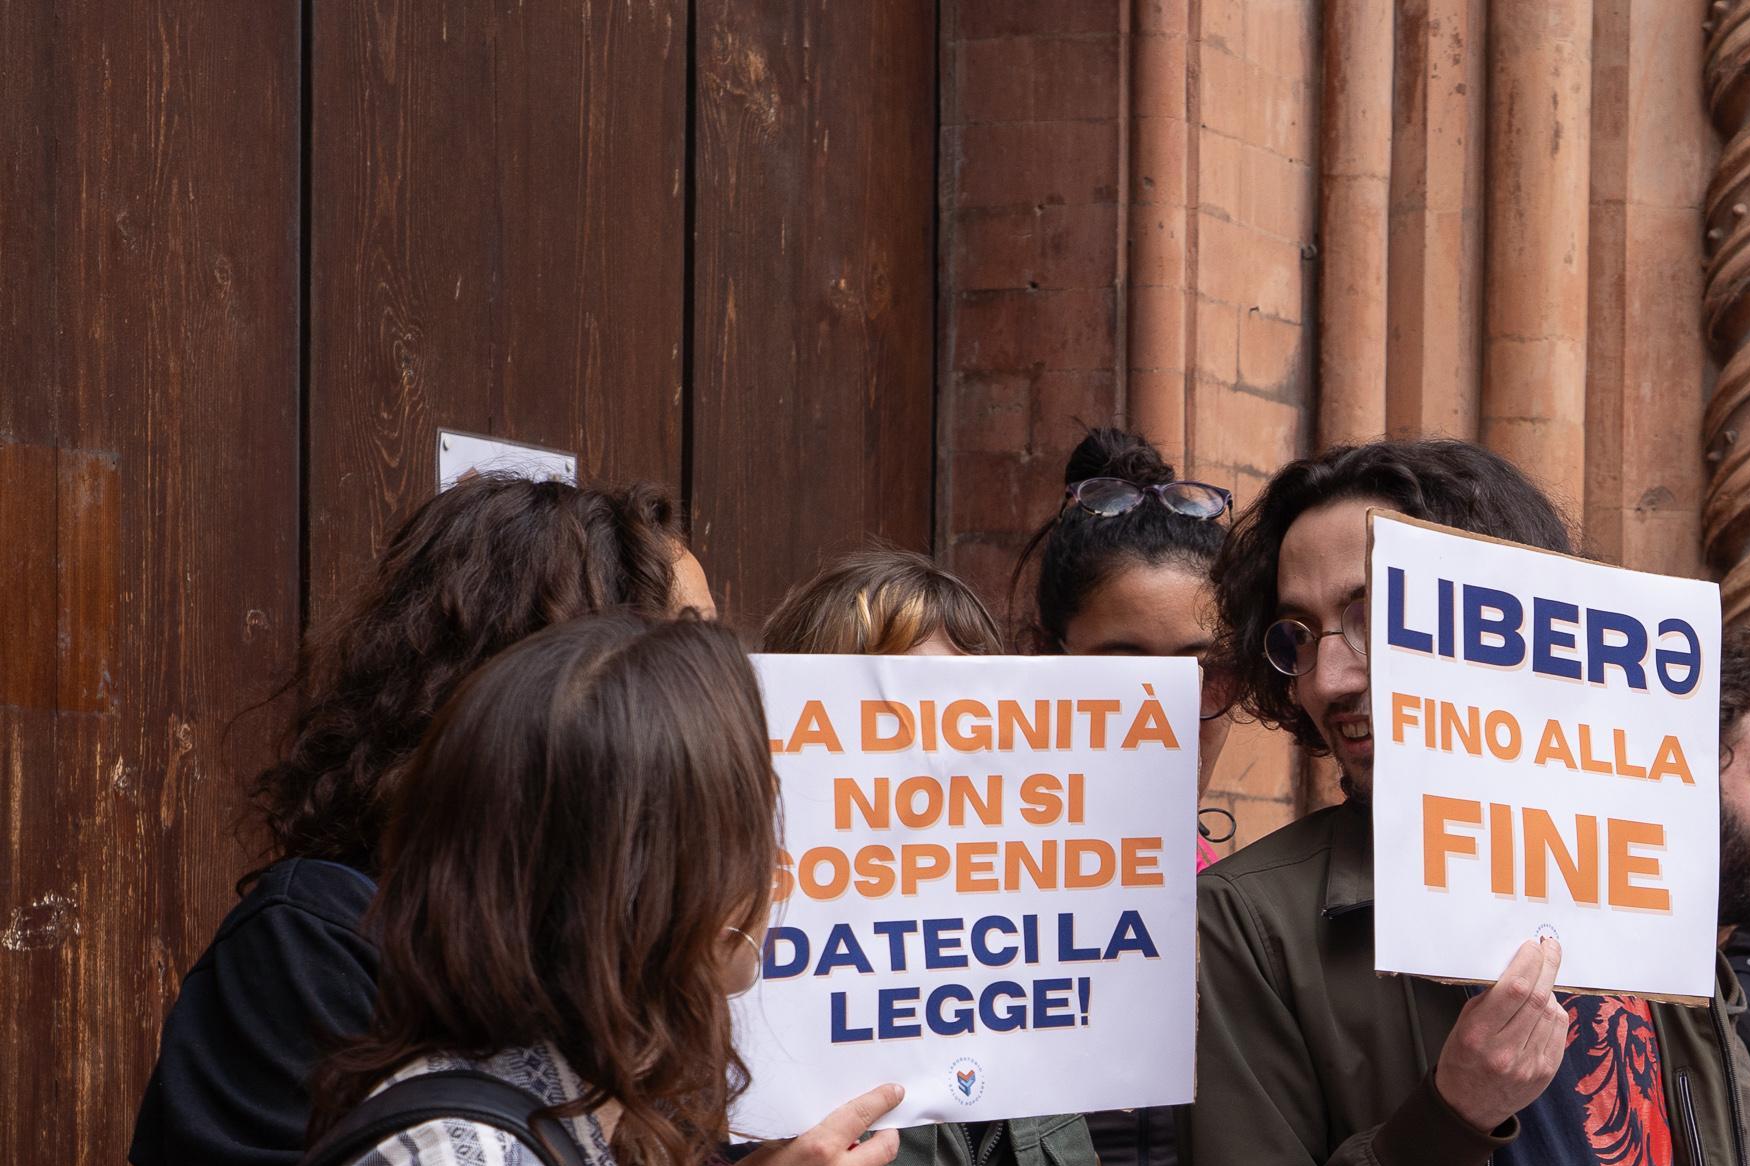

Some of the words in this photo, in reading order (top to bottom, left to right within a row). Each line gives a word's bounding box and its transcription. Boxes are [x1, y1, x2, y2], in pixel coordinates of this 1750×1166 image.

[860, 682, 1180, 752] DIGNITÀ
[1391, 692, 1522, 761] FINO
[1534, 719, 1695, 785] ALLA
[834, 775, 1003, 830] NON
[1019, 773, 1085, 825] SI
[1422, 793, 1670, 912] FINE
[762, 914, 1039, 979] DATECI
[1057, 910, 1158, 962] LA
[830, 976, 1090, 1043] LEGGE!
